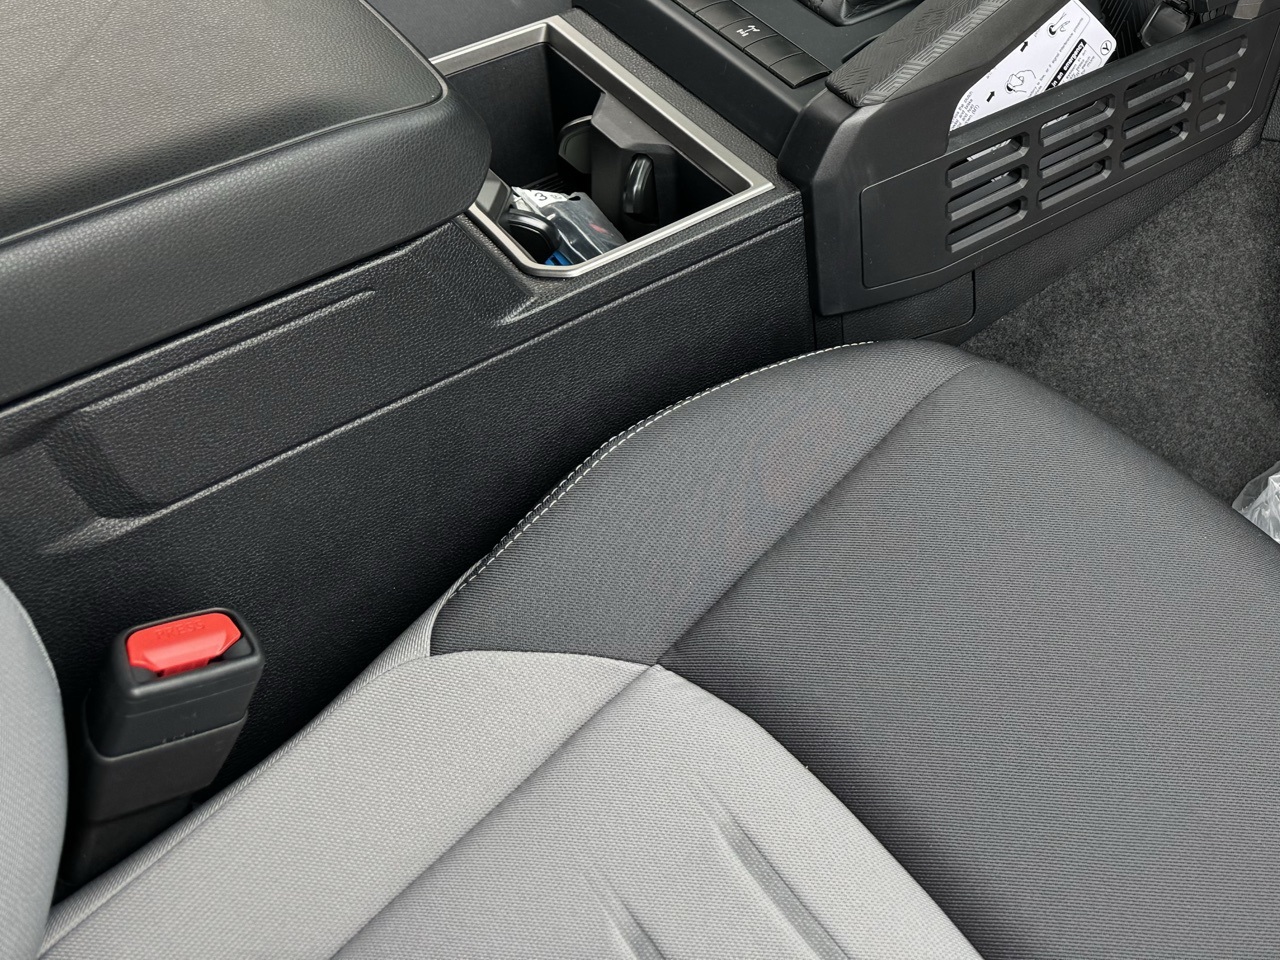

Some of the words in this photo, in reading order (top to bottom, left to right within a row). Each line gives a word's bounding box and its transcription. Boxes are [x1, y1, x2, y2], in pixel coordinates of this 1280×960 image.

[1101, 43, 1111, 53] Y
[1057, 72, 1063, 80] an
[1062, 41, 1085, 71] emergency
